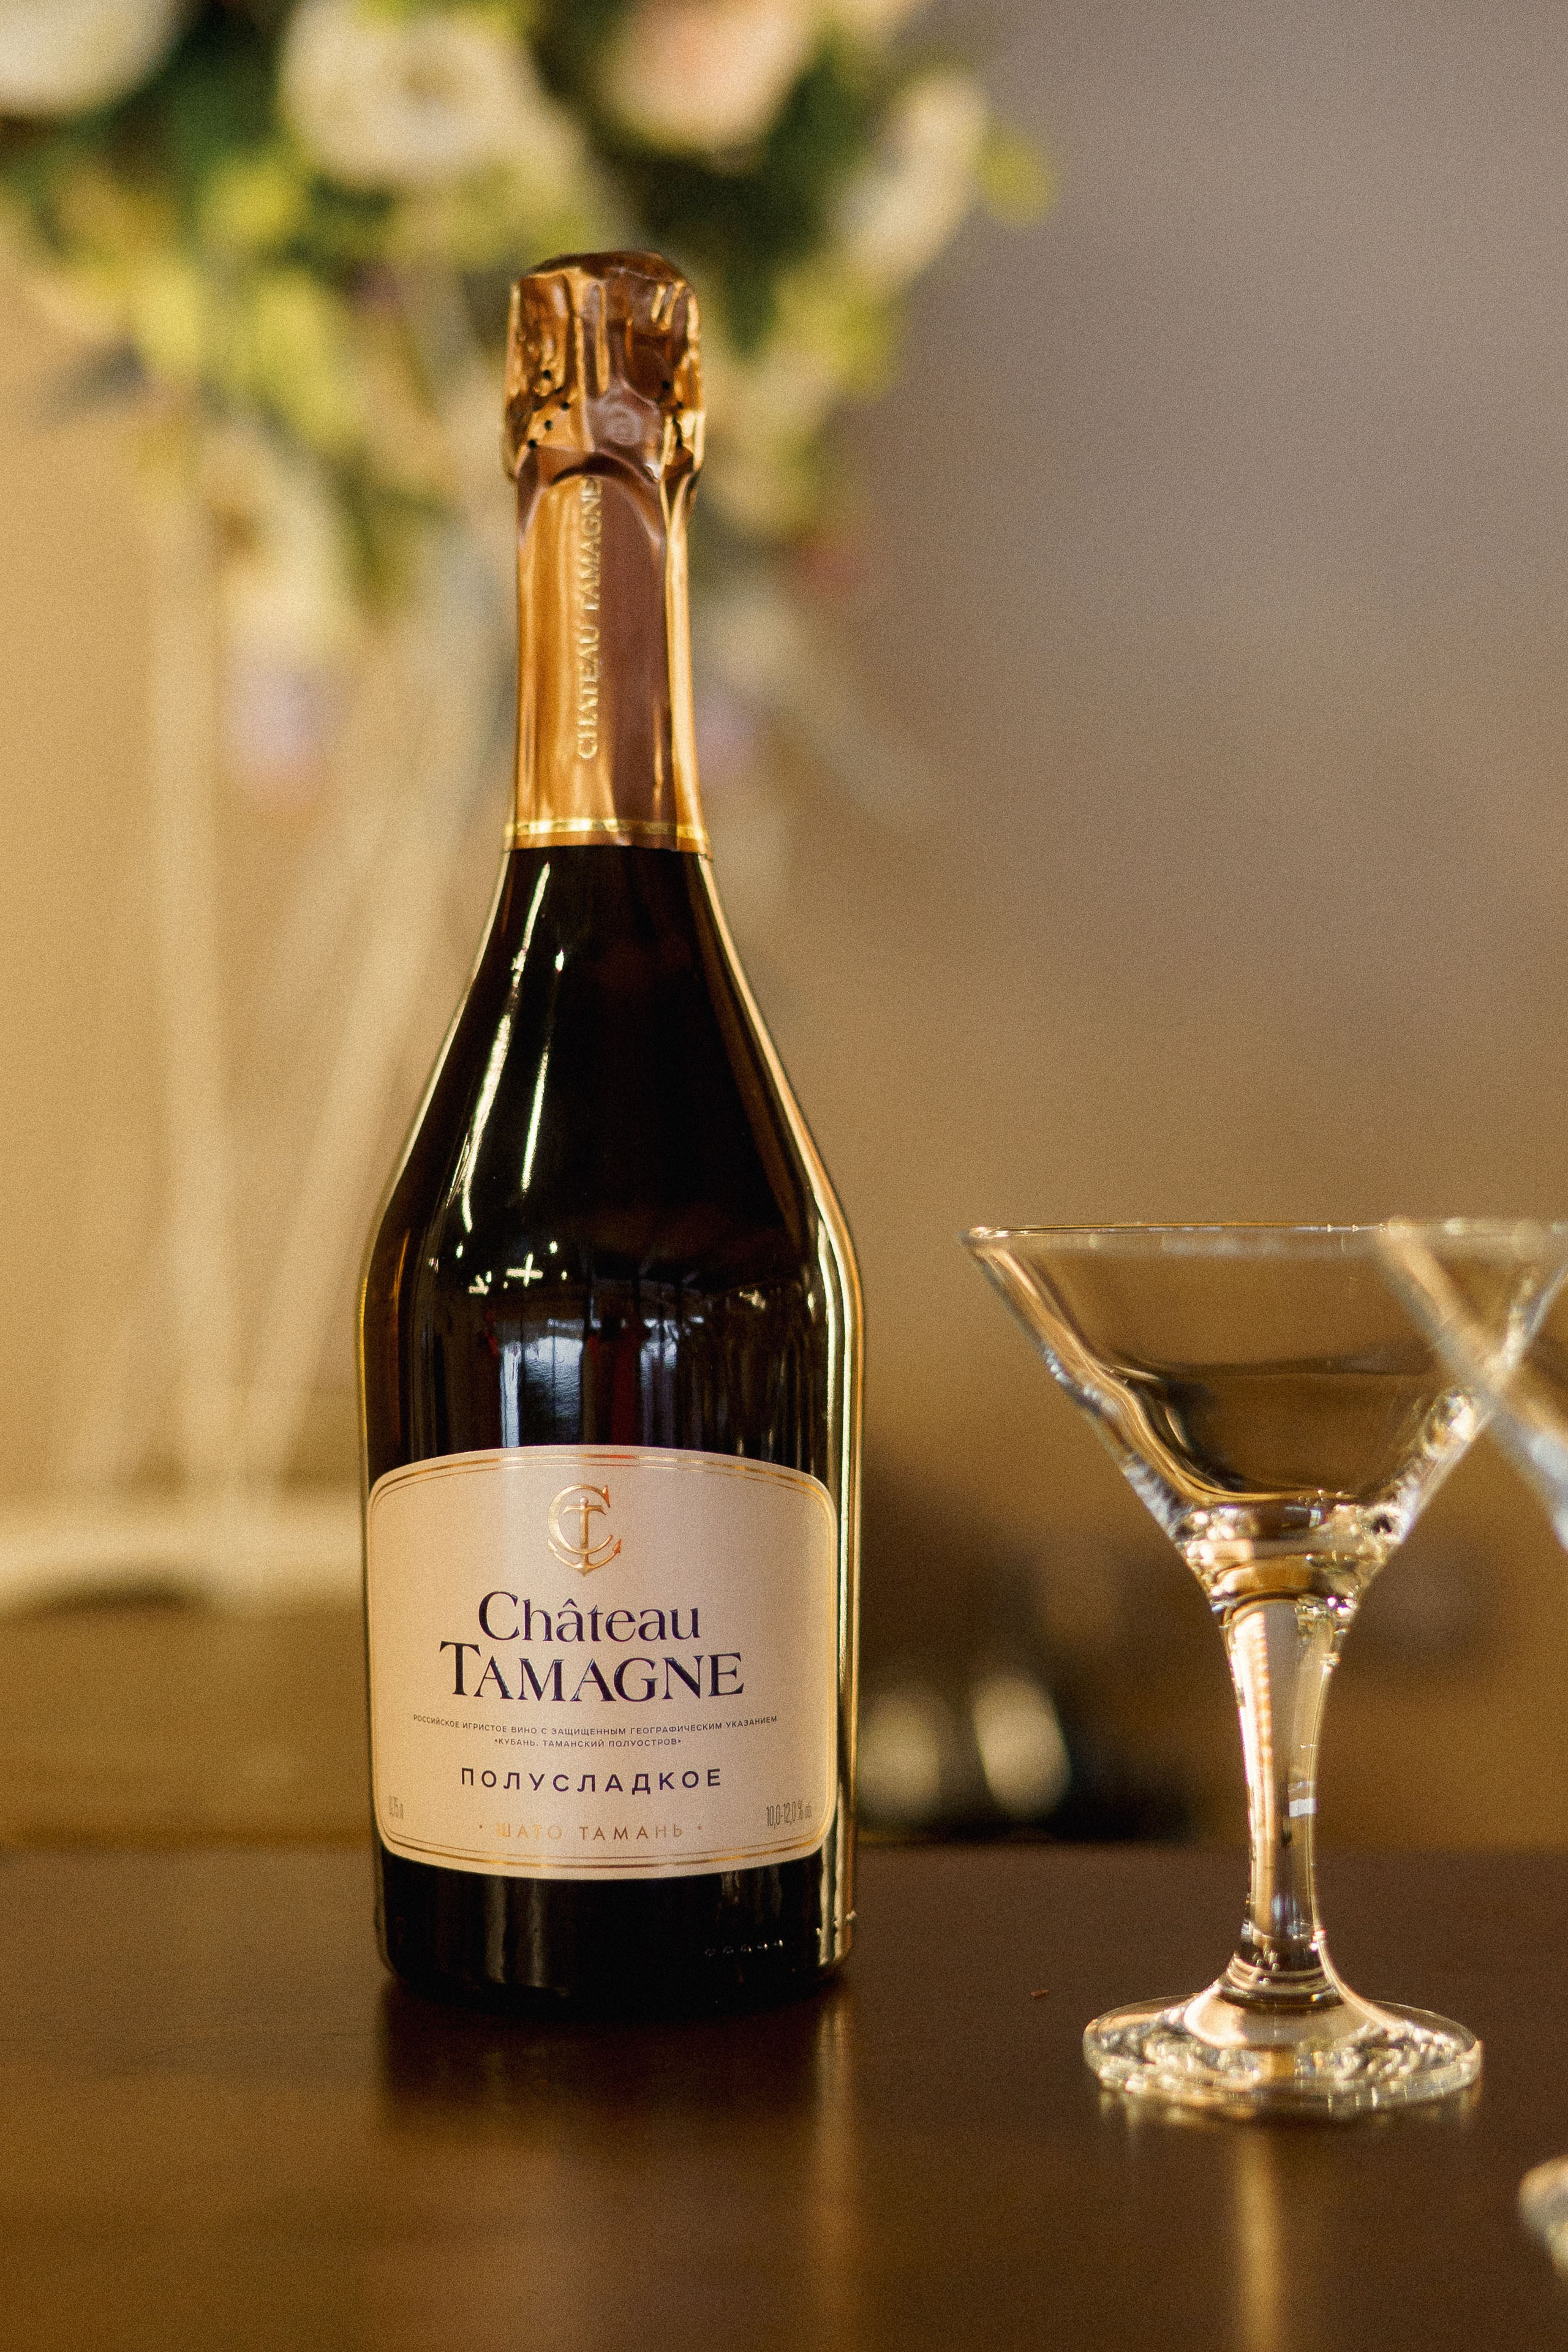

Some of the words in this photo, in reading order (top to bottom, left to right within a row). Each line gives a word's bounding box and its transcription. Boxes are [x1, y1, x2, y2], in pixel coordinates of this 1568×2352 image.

[580, 475, 602, 611] TAMAGNE
[577, 624, 600, 760] CHATEAU
[478, 1591, 701, 1643] Château
[439, 1640, 745, 1702] TAMAGNE
[413, 1714, 459, 1728] РОССИЙСКОЕ
[462, 1722, 507, 1733] ИГРИСТОЕ
[511, 1726, 537, 1735] ВИНО
[551, 1727, 626, 1736] ЗАЩИЩЕННЫМ
[630, 1722, 722, 1735] ГЕОГРАФИЧЕСКИМ
[726, 1716, 777, 1728] УКАЗАНИЕМ
[543, 1738, 605, 1747] ТАМАНСКИЙ
[461, 1768, 721, 1795] ПОЛУСЛАДКОЕ
[496, 1822, 563, 1839] ШАТО
[579, 1824, 684, 1840] ТАМАНЬ
